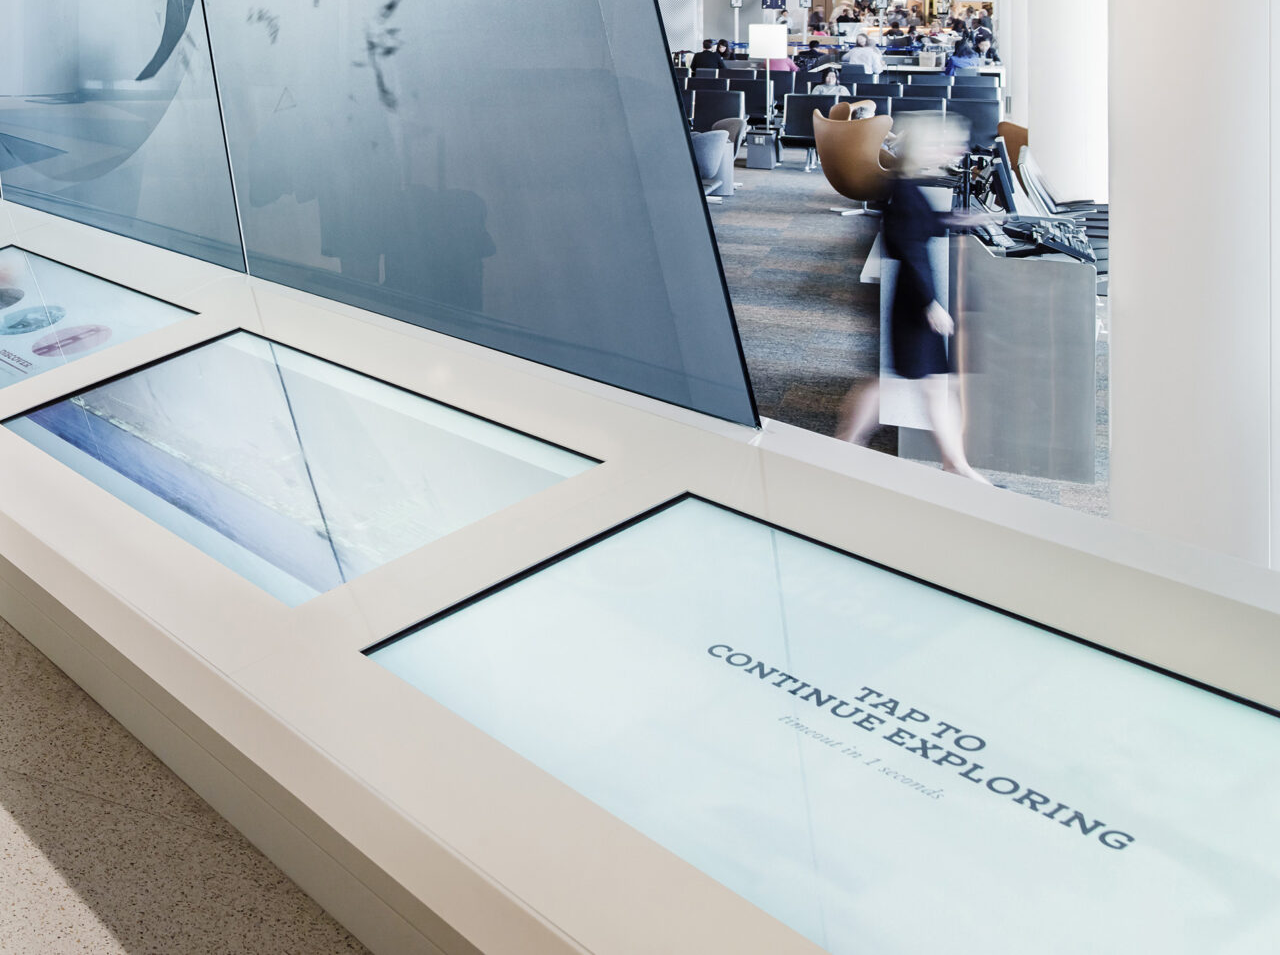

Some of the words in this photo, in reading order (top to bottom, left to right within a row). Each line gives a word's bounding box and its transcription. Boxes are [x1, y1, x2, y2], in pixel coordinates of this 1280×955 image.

[707, 644, 886, 732] CONTINUE
[882, 727, 1135, 850] EXPLORING
[778, 714, 844, 748] timeout
[841, 746, 862, 759] in
[877, 766, 944, 801] seconds
[854, 686, 931, 724] TAP
[931, 721, 986, 752] TO
